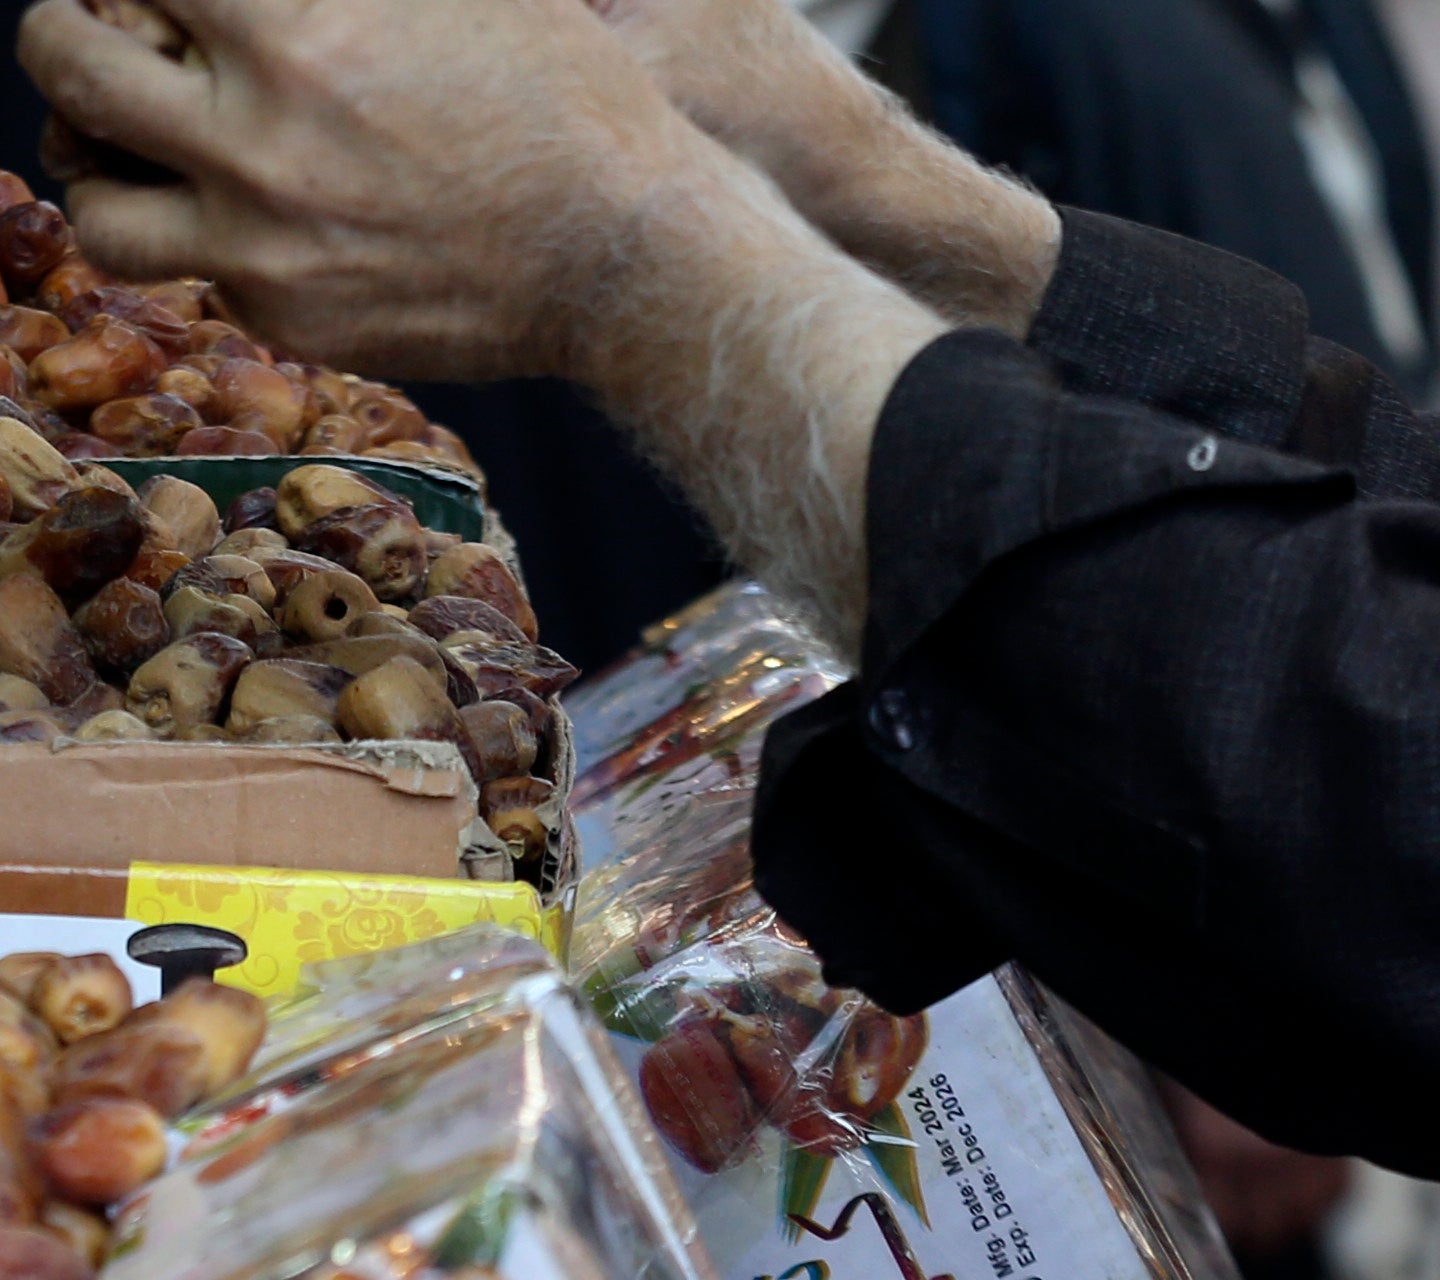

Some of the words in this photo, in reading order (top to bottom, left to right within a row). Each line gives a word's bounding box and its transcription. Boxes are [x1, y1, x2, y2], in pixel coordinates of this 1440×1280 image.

[907, 1086, 944, 1135] 2024
[929, 1072, 966, 1123] 2026
[935, 1137, 964, 1178] Mar
[958, 1122, 986, 1165] Dec
[956, 1177, 992, 1233] Date:
[979, 1165, 1013, 1221] Date:
[986, 1231, 1015, 1280] Mfg.
[1008, 1220, 1036, 1268] Exp.
